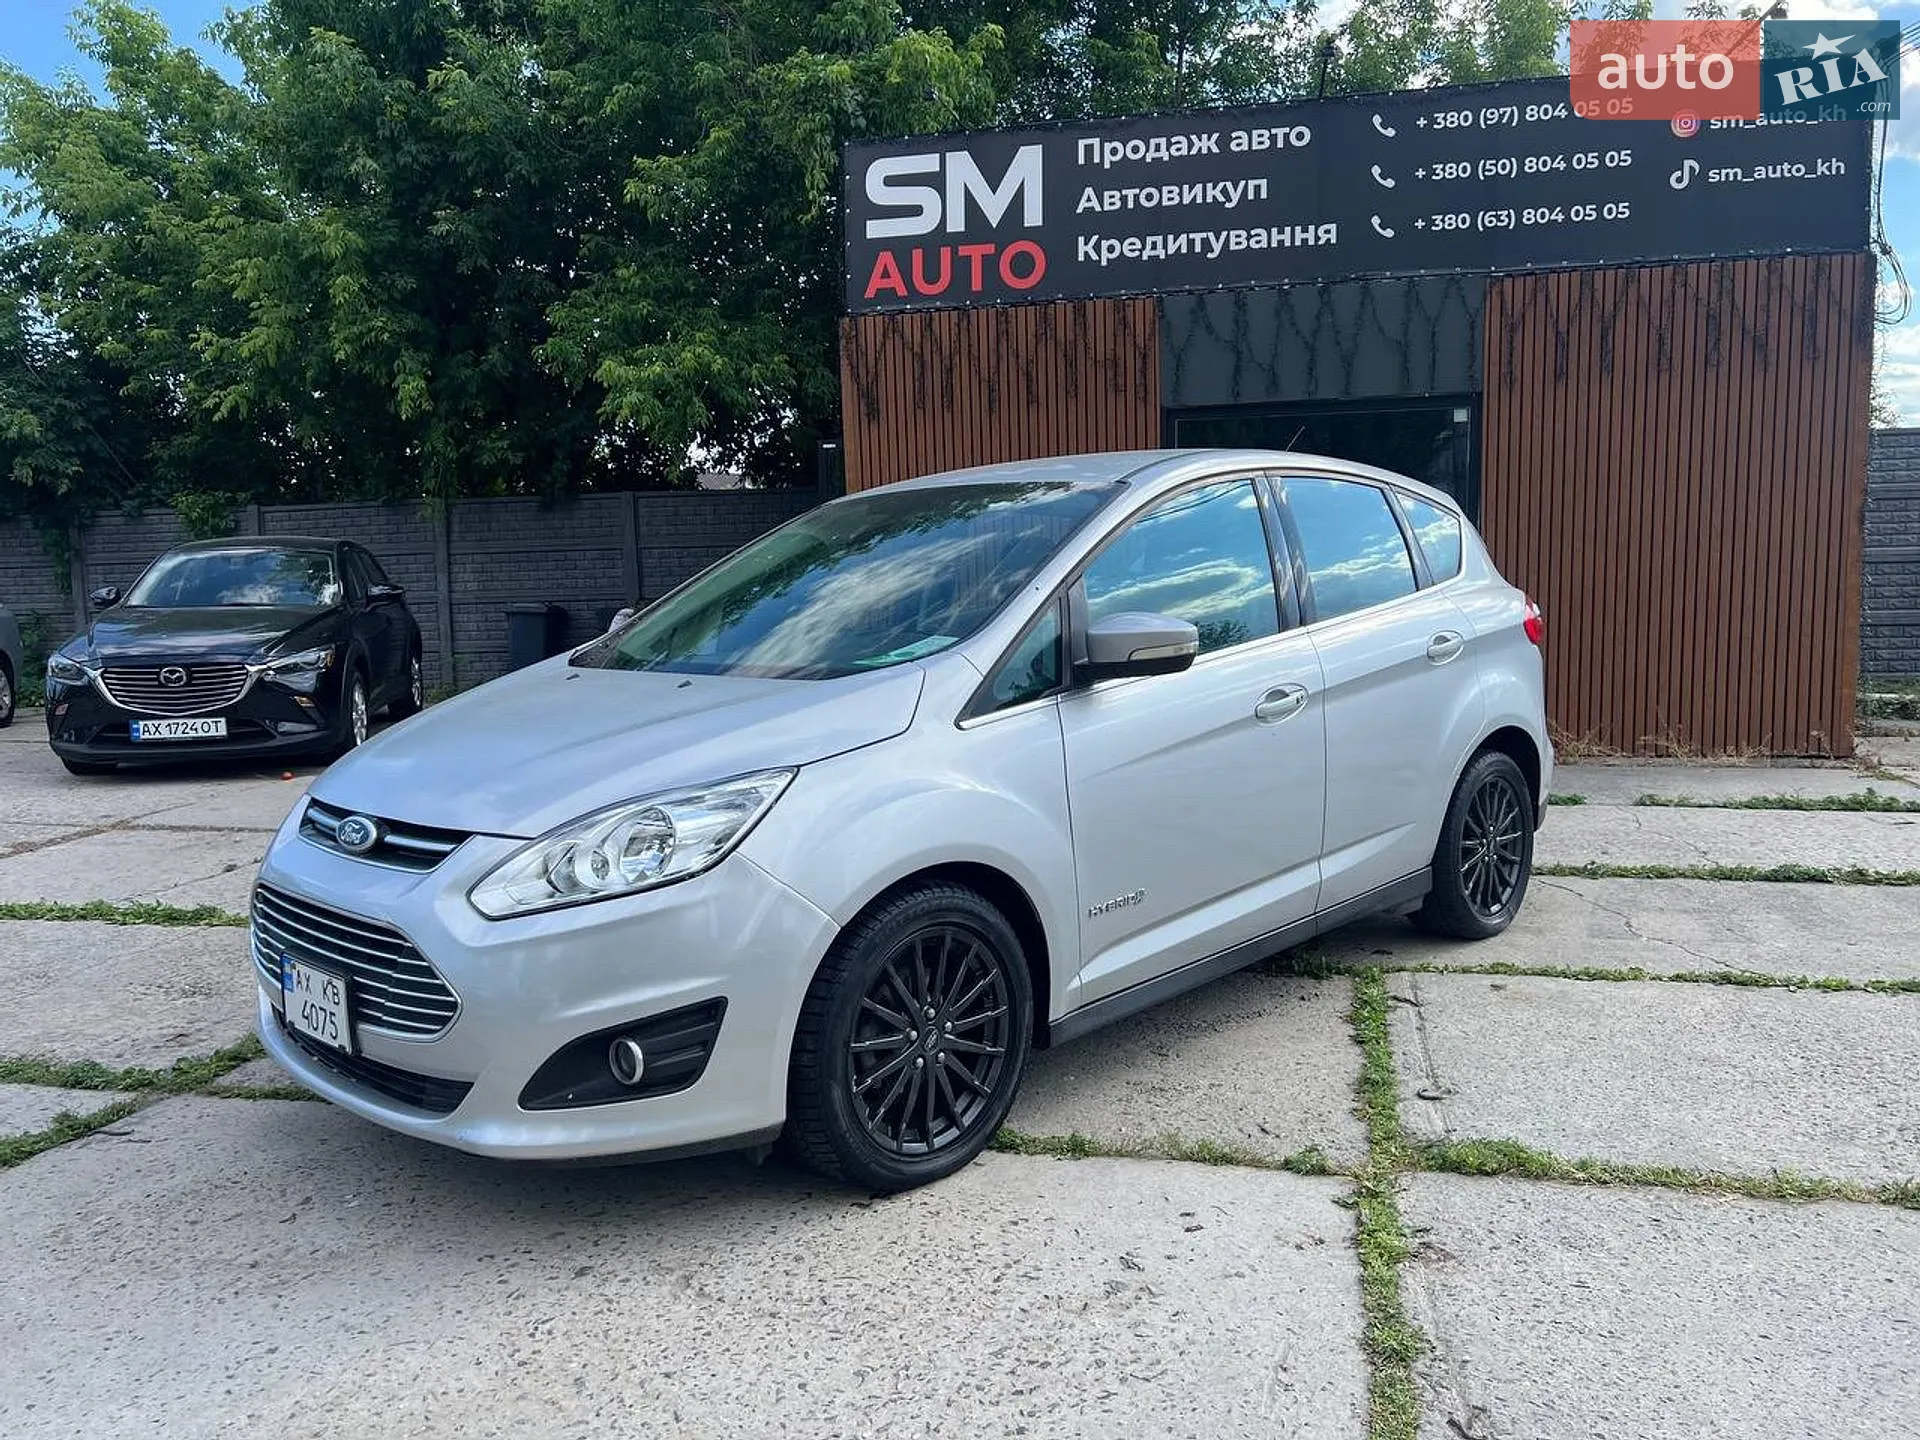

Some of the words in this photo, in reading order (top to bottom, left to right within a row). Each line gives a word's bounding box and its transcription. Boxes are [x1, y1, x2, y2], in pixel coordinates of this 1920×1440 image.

[1432, 110, 1473, 129] 380
[1479, 105, 1519, 129] (97)
[1525, 102, 1568, 121] 804
[1573, 99, 1601, 118] 05
[1606, 97, 1634, 115] 05
[1076, 131, 1222, 169] Продаж
[1230, 125, 1312, 153] авто
[1431, 161, 1472, 180] 380
[1477, 157, 1518, 181] (50)
[1523, 154, 1567, 173] 804
[1572, 152, 1599, 170] 05
[1604, 150, 1632, 168] 05
[1708, 157, 1846, 183] sm_auto_kh
[865, 143, 1044, 239] SM
[1075, 178, 1269, 214] Автовикуп
[1430, 213, 1471, 231] 380
[1476, 208, 1516, 232] (63)
[1522, 206, 1565, 225] 804
[1570, 204, 1597, 222] 05
[1602, 202, 1630, 219] 05
[1076, 222, 1338, 265] Кредитування
[864, 239, 1047, 298] AUTO
[142, 723, 162, 736] AX
[165, 721, 198, 735] 1724
[200, 720, 222, 734] OT
[301, 999, 339, 1041] 4075
